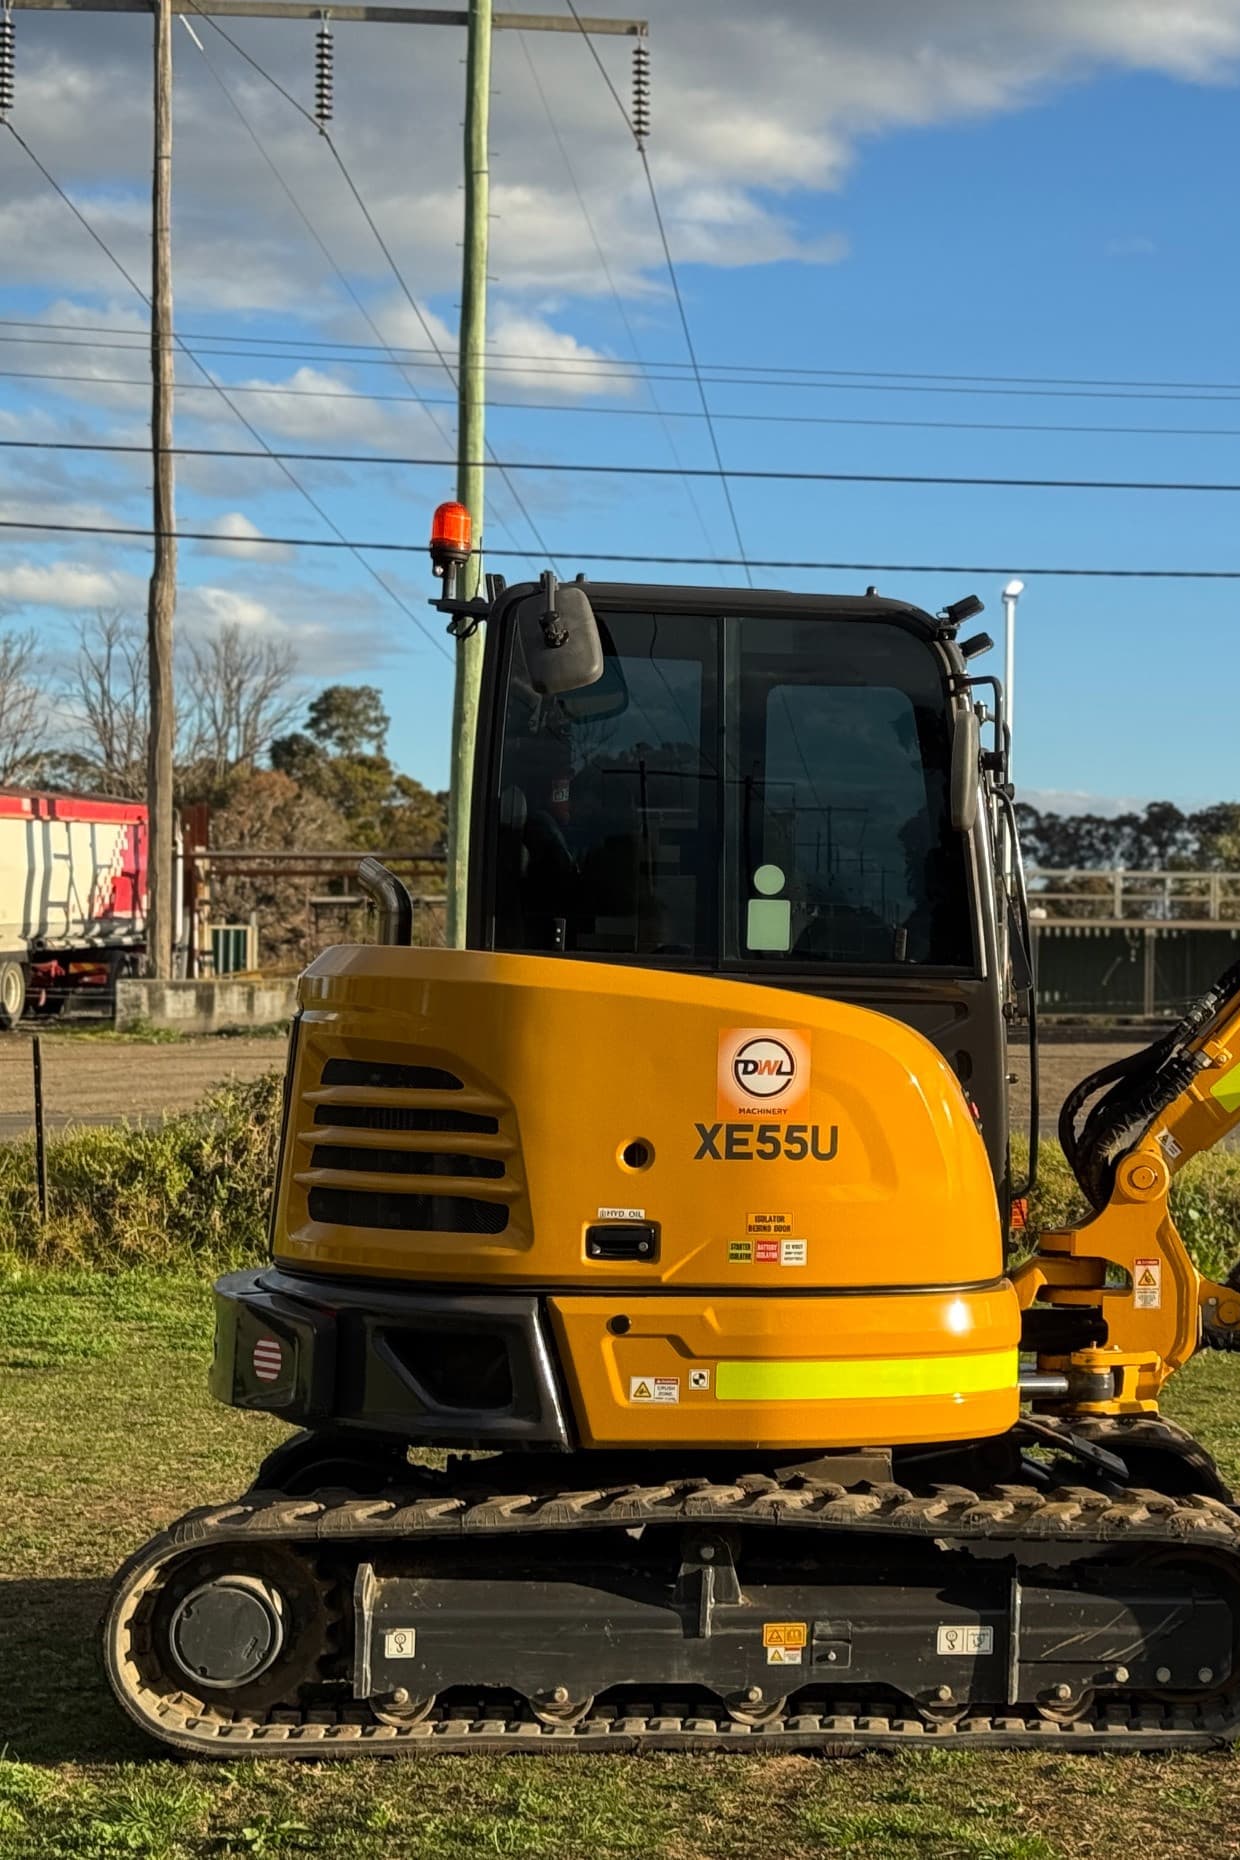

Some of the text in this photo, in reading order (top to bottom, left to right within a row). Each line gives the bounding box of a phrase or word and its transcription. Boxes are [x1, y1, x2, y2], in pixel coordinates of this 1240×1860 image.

[735, 1059, 794, 1075] DWL
[694, 1123, 838, 1161] XE55U
[629, 1210, 643, 1218] OIL
[754, 1215, 785, 1223] ISOLATOR
